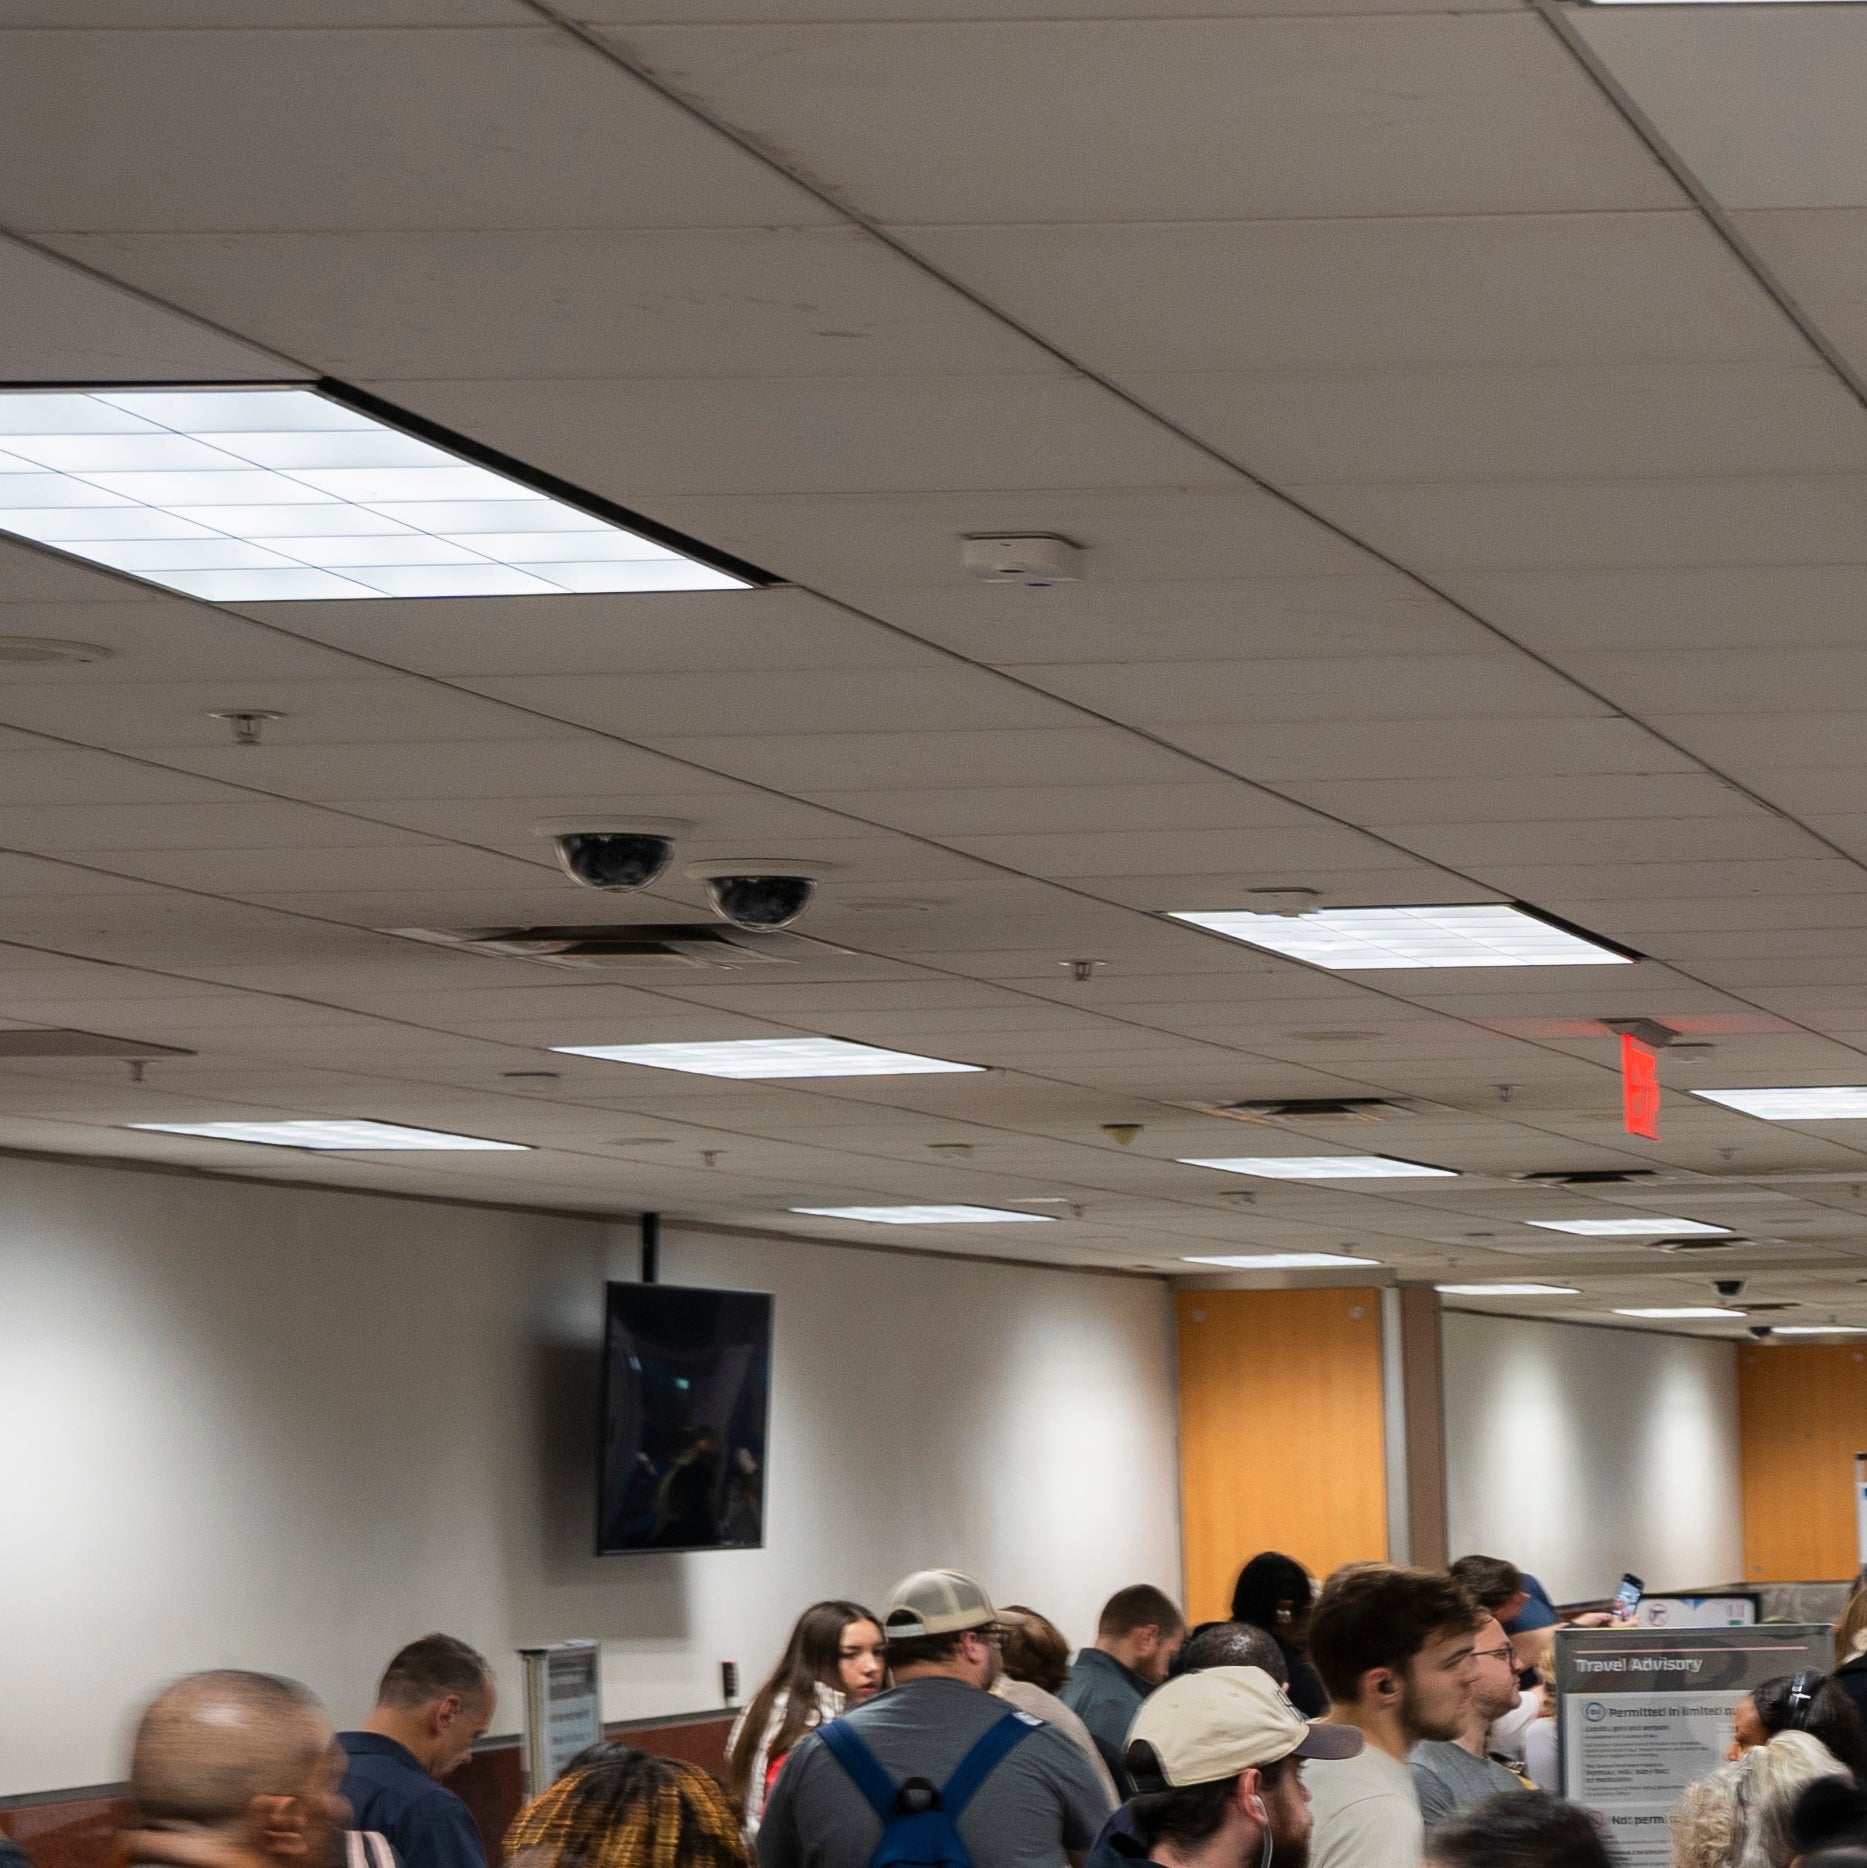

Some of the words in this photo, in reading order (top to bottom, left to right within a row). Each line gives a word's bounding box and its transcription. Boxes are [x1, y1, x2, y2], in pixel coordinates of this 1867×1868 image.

[1575, 1658, 1627, 1672] Travel
[1629, 1657, 1703, 1673] Advisory
[1609, 1707, 1666, 1717] Permitted
[1669, 1707, 1679, 1716] in
[1682, 1706, 1722, 1716] limited
[1612, 1816, 1632, 1825] Not
